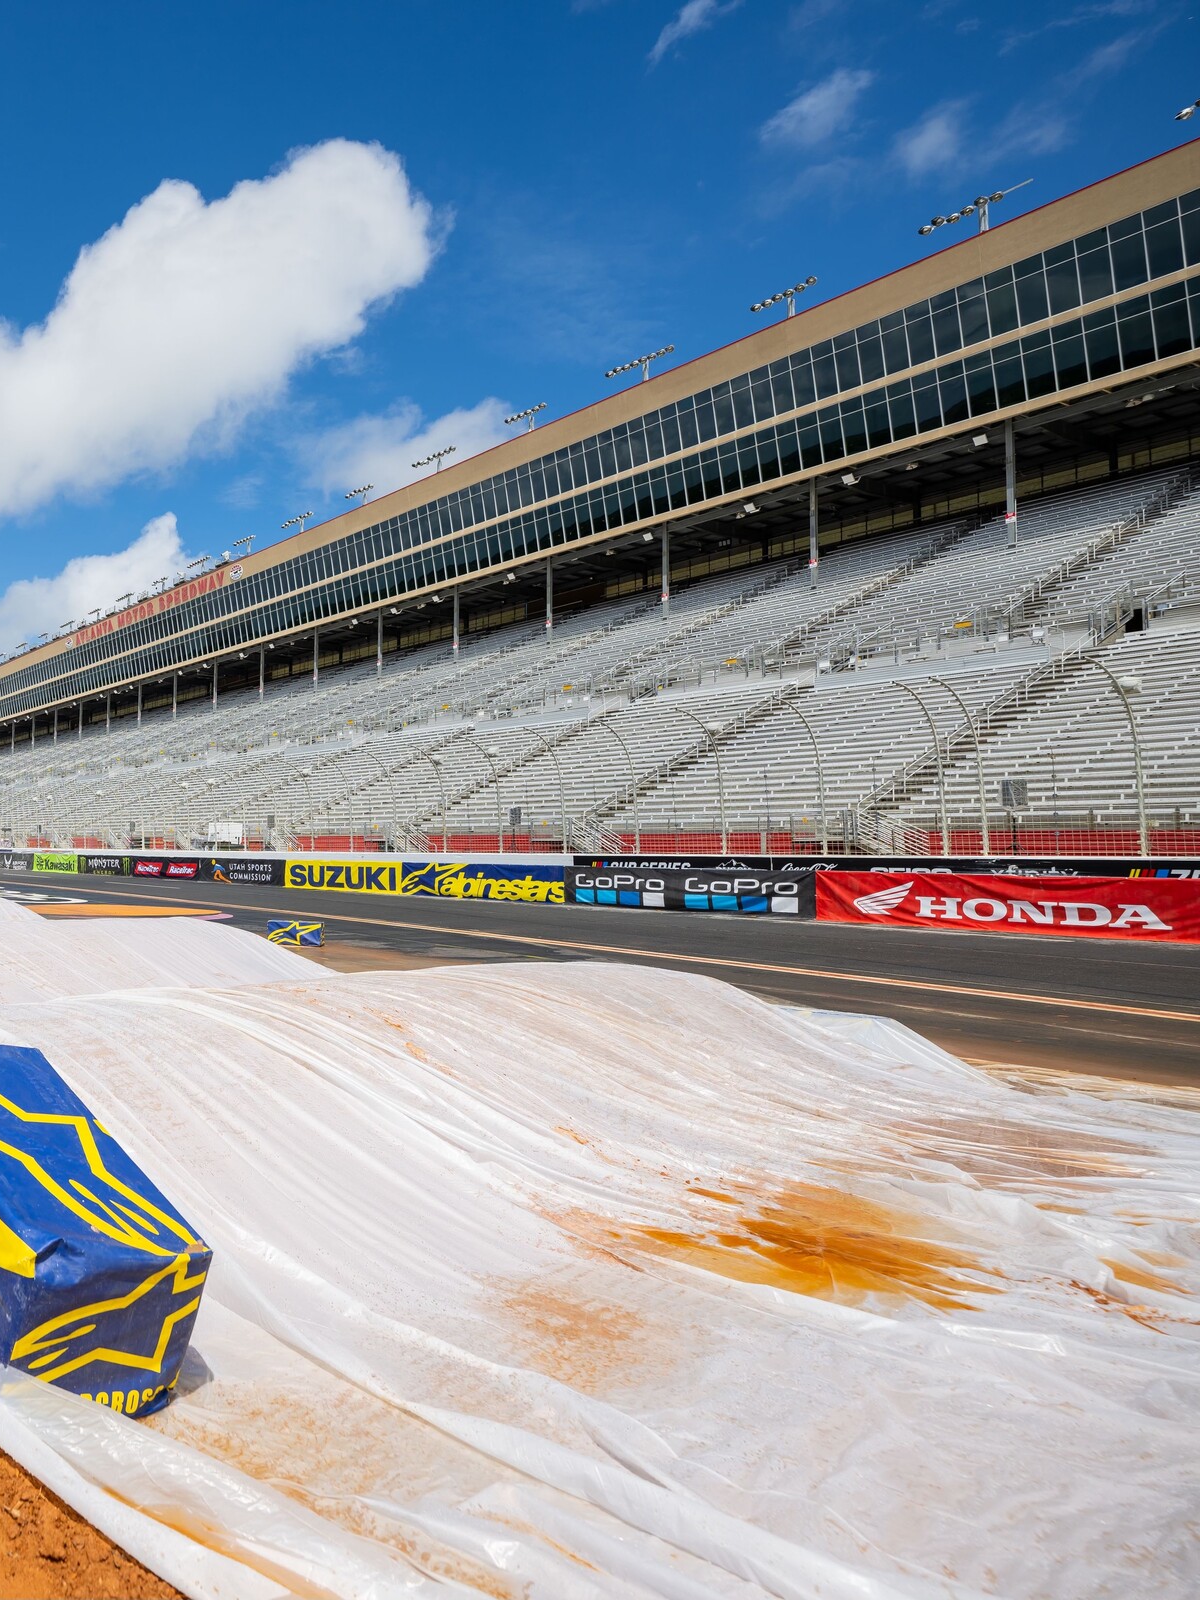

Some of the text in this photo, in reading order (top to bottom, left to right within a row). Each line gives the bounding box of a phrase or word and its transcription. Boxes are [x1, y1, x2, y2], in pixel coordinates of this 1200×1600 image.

[75, 620, 114, 646] ATLANTA
[117, 602, 155, 628] MOTOR
[158, 570, 225, 611] SPEEDWAY
[44, 859, 75, 872] Kawasaki
[87, 857, 121, 869] MONSTER
[169, 865, 194, 874] RaceTrac
[229, 863, 272, 872] UTAH SPORTS
[229, 872, 272, 881] COMMISSION
[289, 863, 397, 891] SUZUKI
[575, 873, 665, 891] GoPro
[440, 871, 565, 903] alpinestars
[684, 877, 798, 895] GoPro
[914, 896, 1173, 931] HONDA
